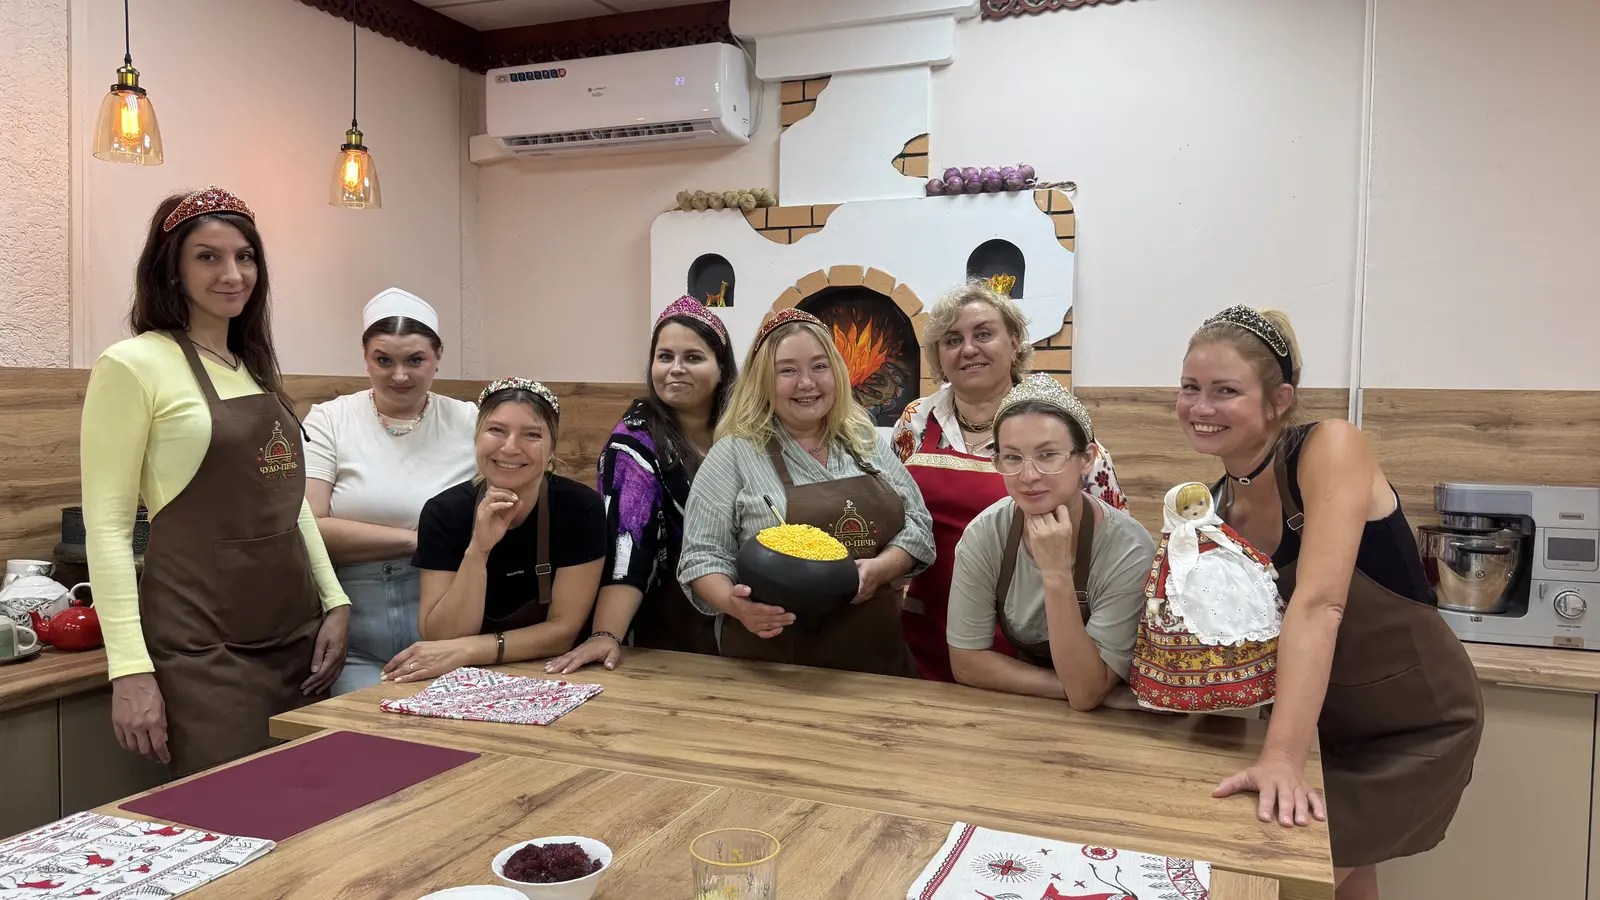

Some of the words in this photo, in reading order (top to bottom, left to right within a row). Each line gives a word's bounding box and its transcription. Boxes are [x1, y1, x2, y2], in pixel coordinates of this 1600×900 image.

[675, 76, 685, 85] 23
[260, 462, 297, 473] ЧУДО-ПЕЧЬ
[841, 539, 876, 547] О-ПЕЧЬ
